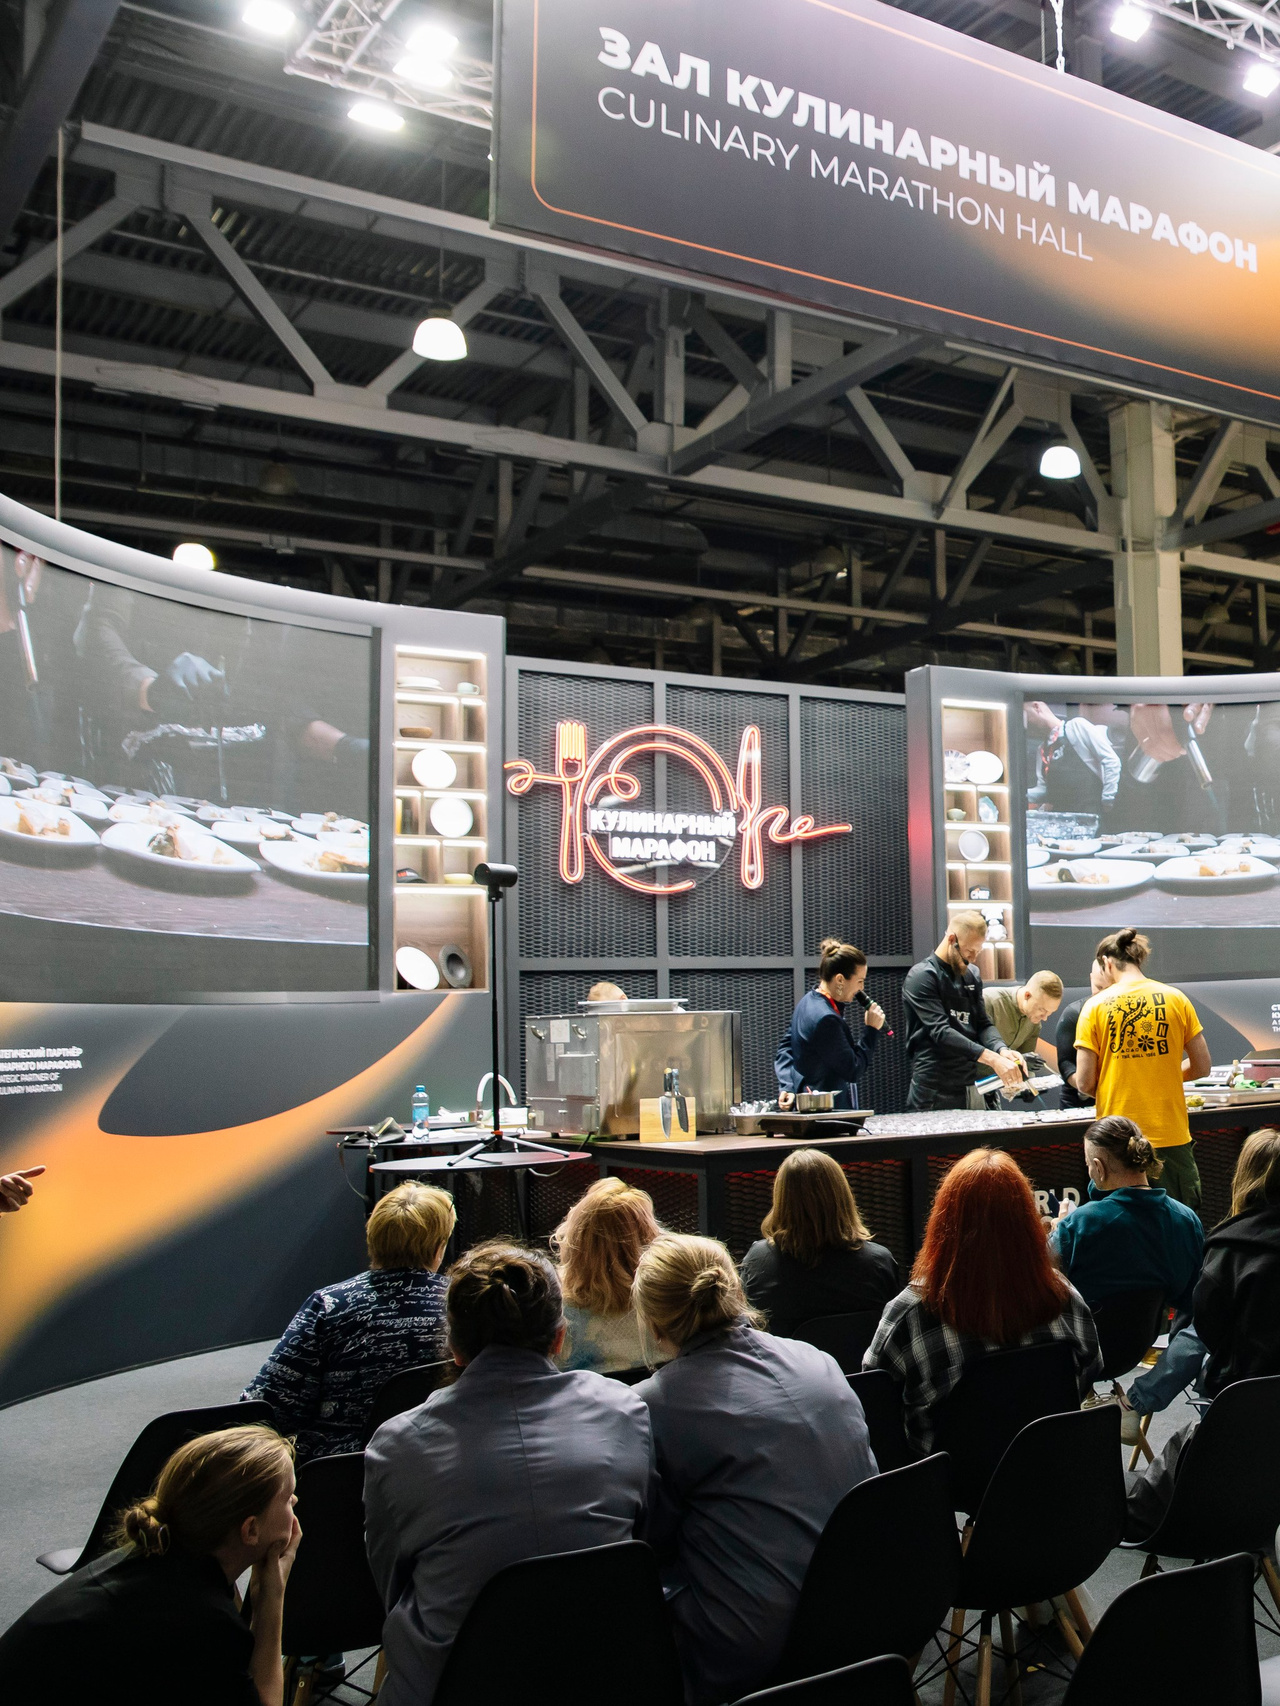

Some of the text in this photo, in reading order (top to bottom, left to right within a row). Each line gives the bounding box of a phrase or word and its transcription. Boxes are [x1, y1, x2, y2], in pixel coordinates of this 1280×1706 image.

[597, 86, 1094, 262] CULINARY MARATHON HALL
[598, 26, 1258, 273] ЗАЛ КУЛИНАРНЫЙ МАРАФОН
[590, 809, 736, 837] КУЛИНАРНЫЙ
[611, 836, 716, 861] МАРАФОН
[1152, 993, 1169, 1055] VANS
